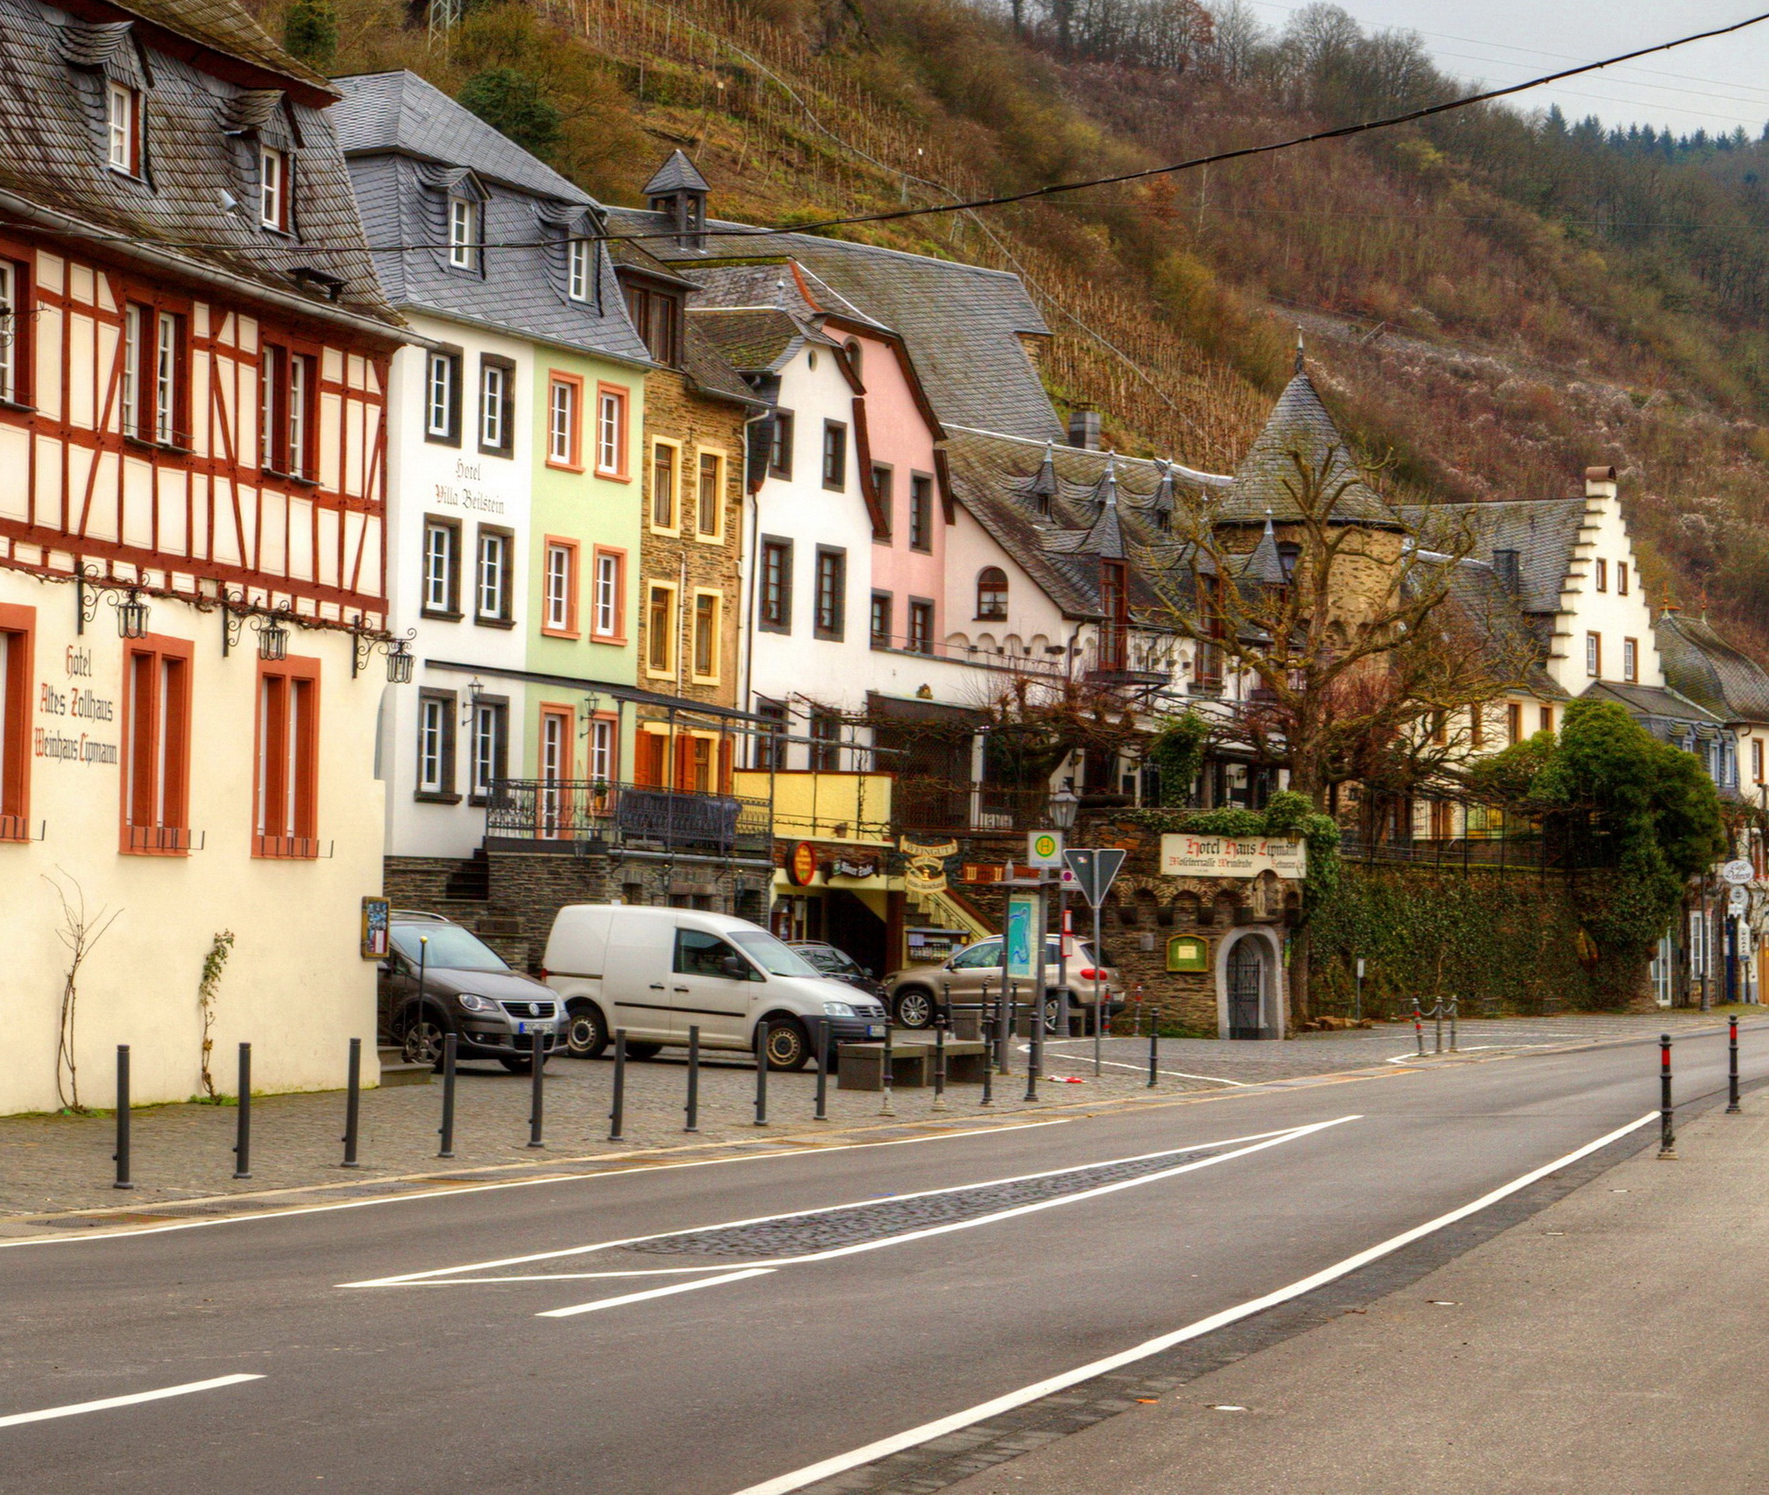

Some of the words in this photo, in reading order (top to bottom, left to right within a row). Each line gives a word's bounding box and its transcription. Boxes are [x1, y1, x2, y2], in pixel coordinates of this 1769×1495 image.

[455, 457, 481, 482] Hotel
[435, 484, 459, 506] Villa
[462, 488, 504, 515] Beilstein
[66, 644, 93, 681] Hotel
[39, 682, 66, 717] Altes
[70, 687, 114, 724] Zollhaus
[34, 726, 79, 765] Weinhaus
[79, 732, 118, 768] Lipmann
[1186, 837, 1221, 858] Hotel
[1224, 838, 1257, 859] Haus
